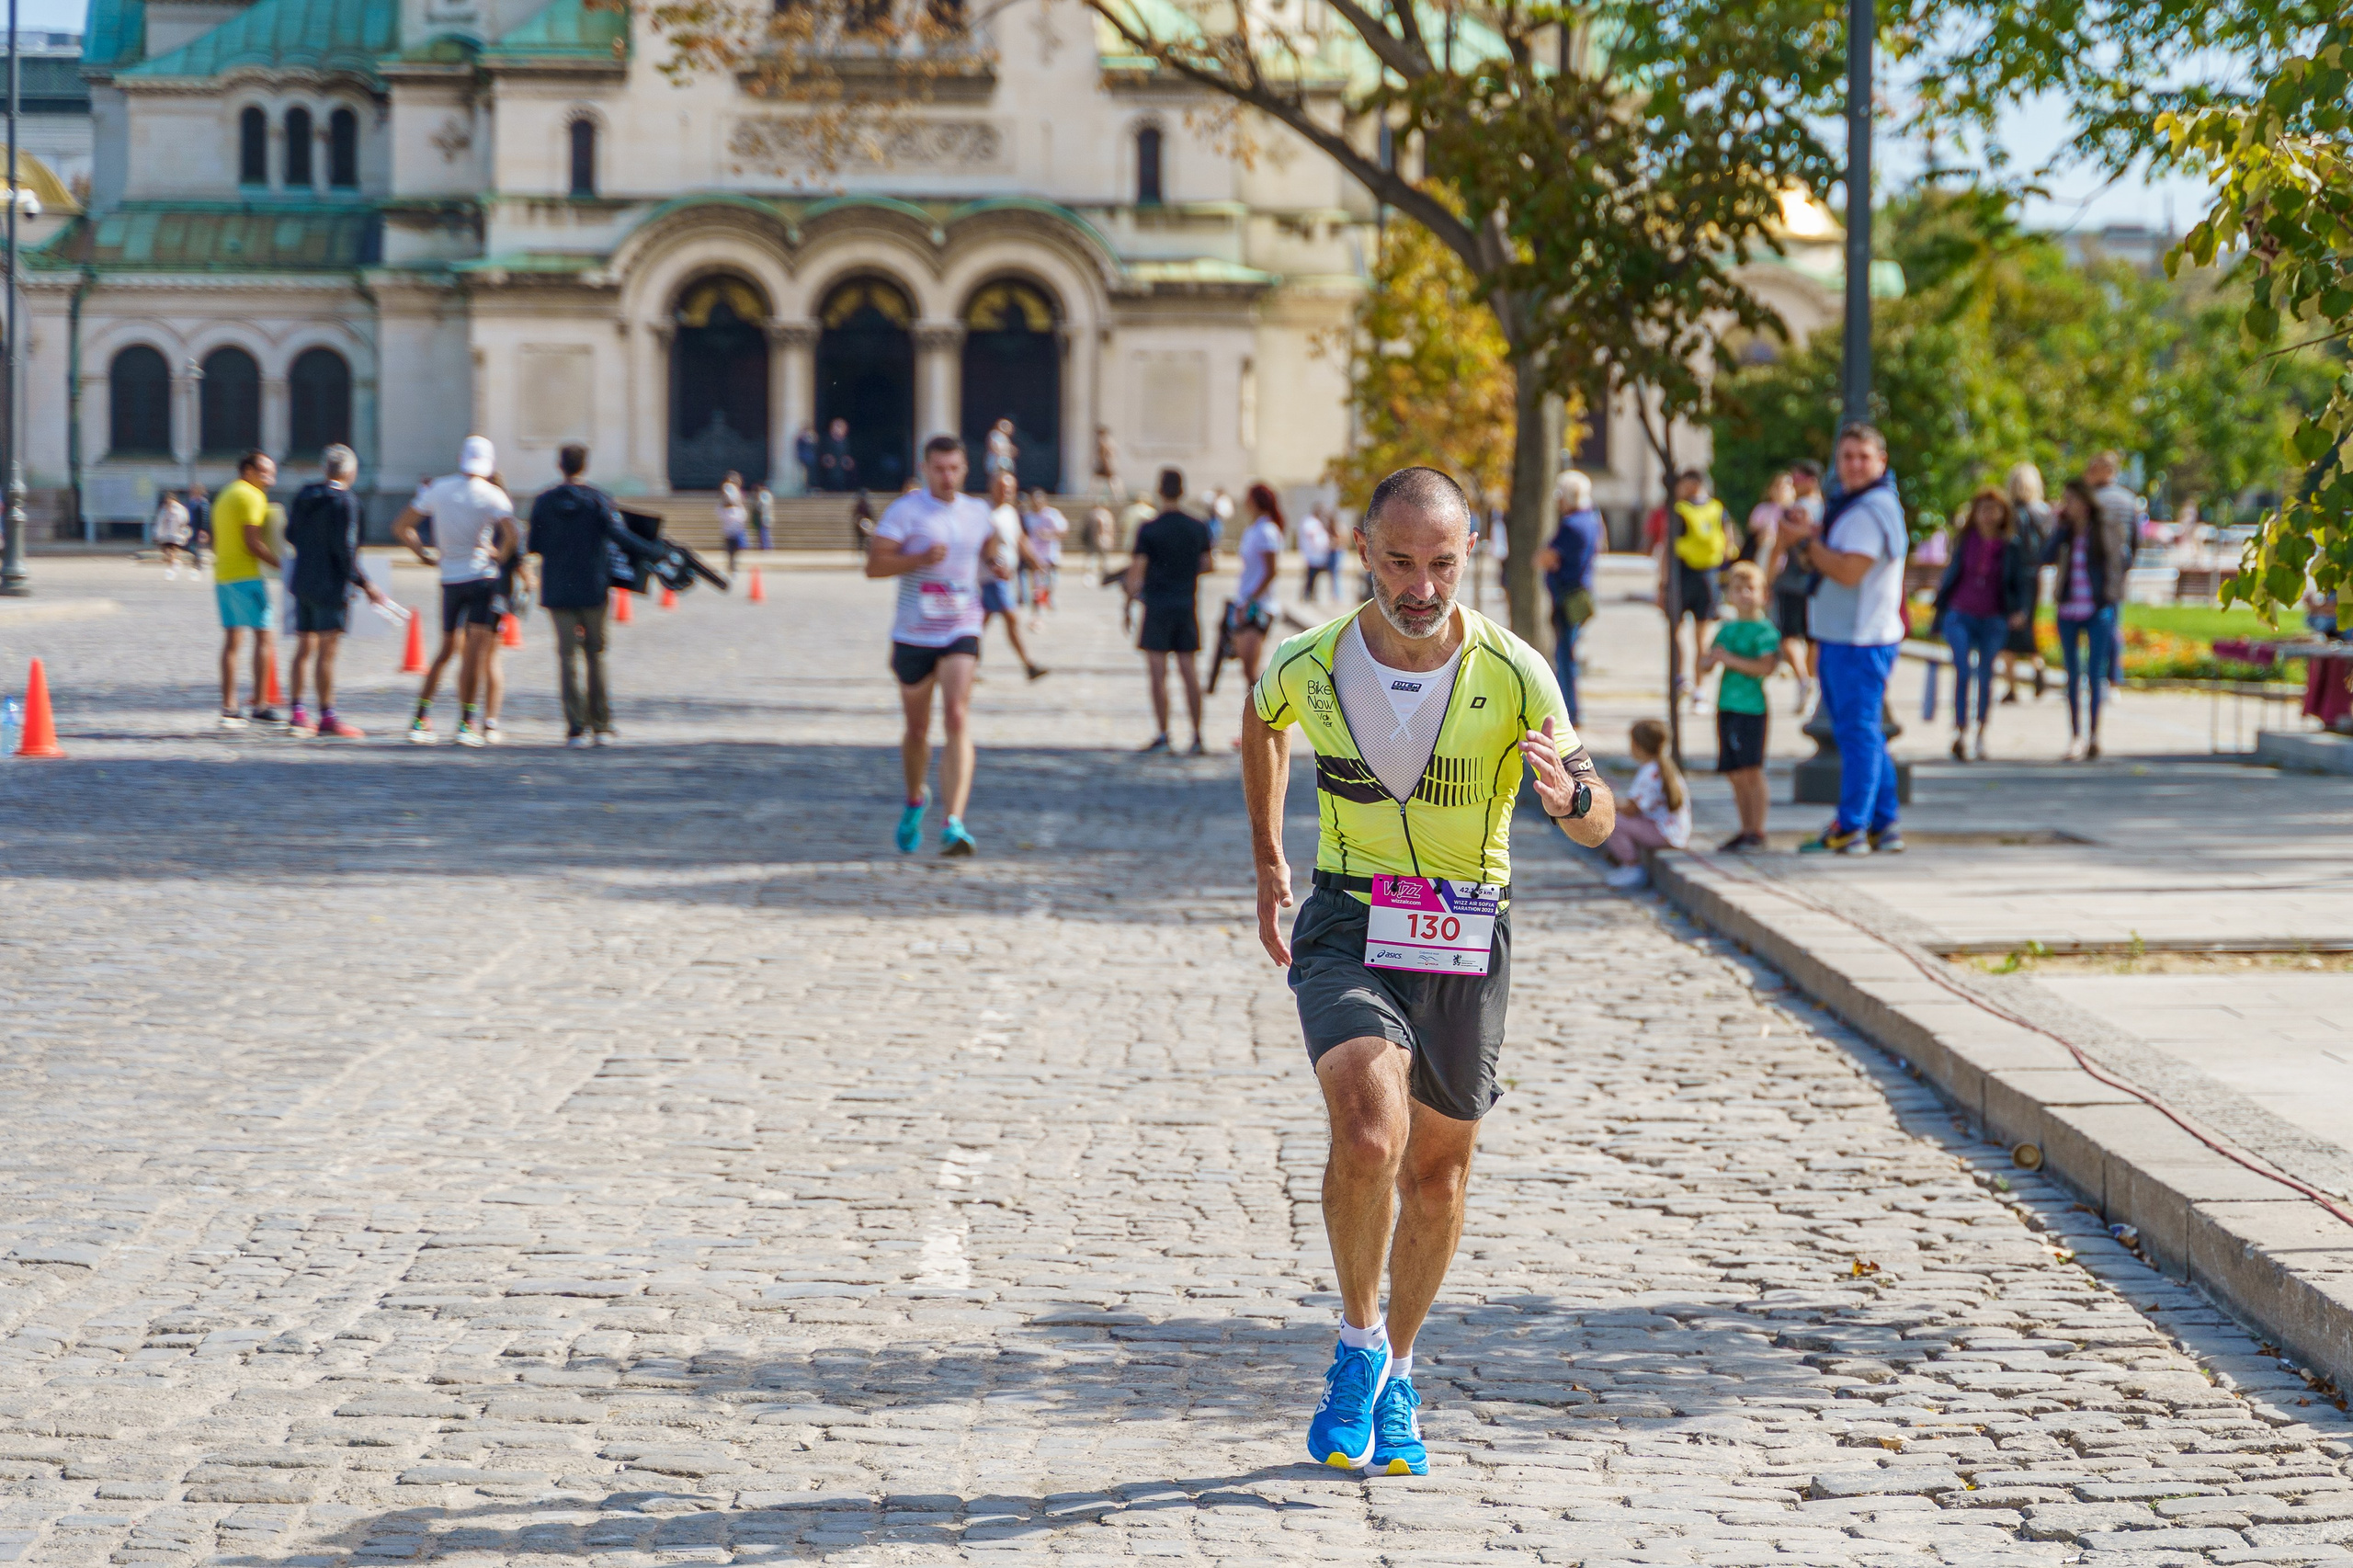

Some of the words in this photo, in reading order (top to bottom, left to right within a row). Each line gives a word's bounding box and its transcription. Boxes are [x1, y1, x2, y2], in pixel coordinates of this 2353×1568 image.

[1307, 679, 1332, 696] Bike
[1307, 695, 1334, 710] Now
[1391, 898, 1422, 906] wizzair.com
[1407, 914, 1461, 941] 130
